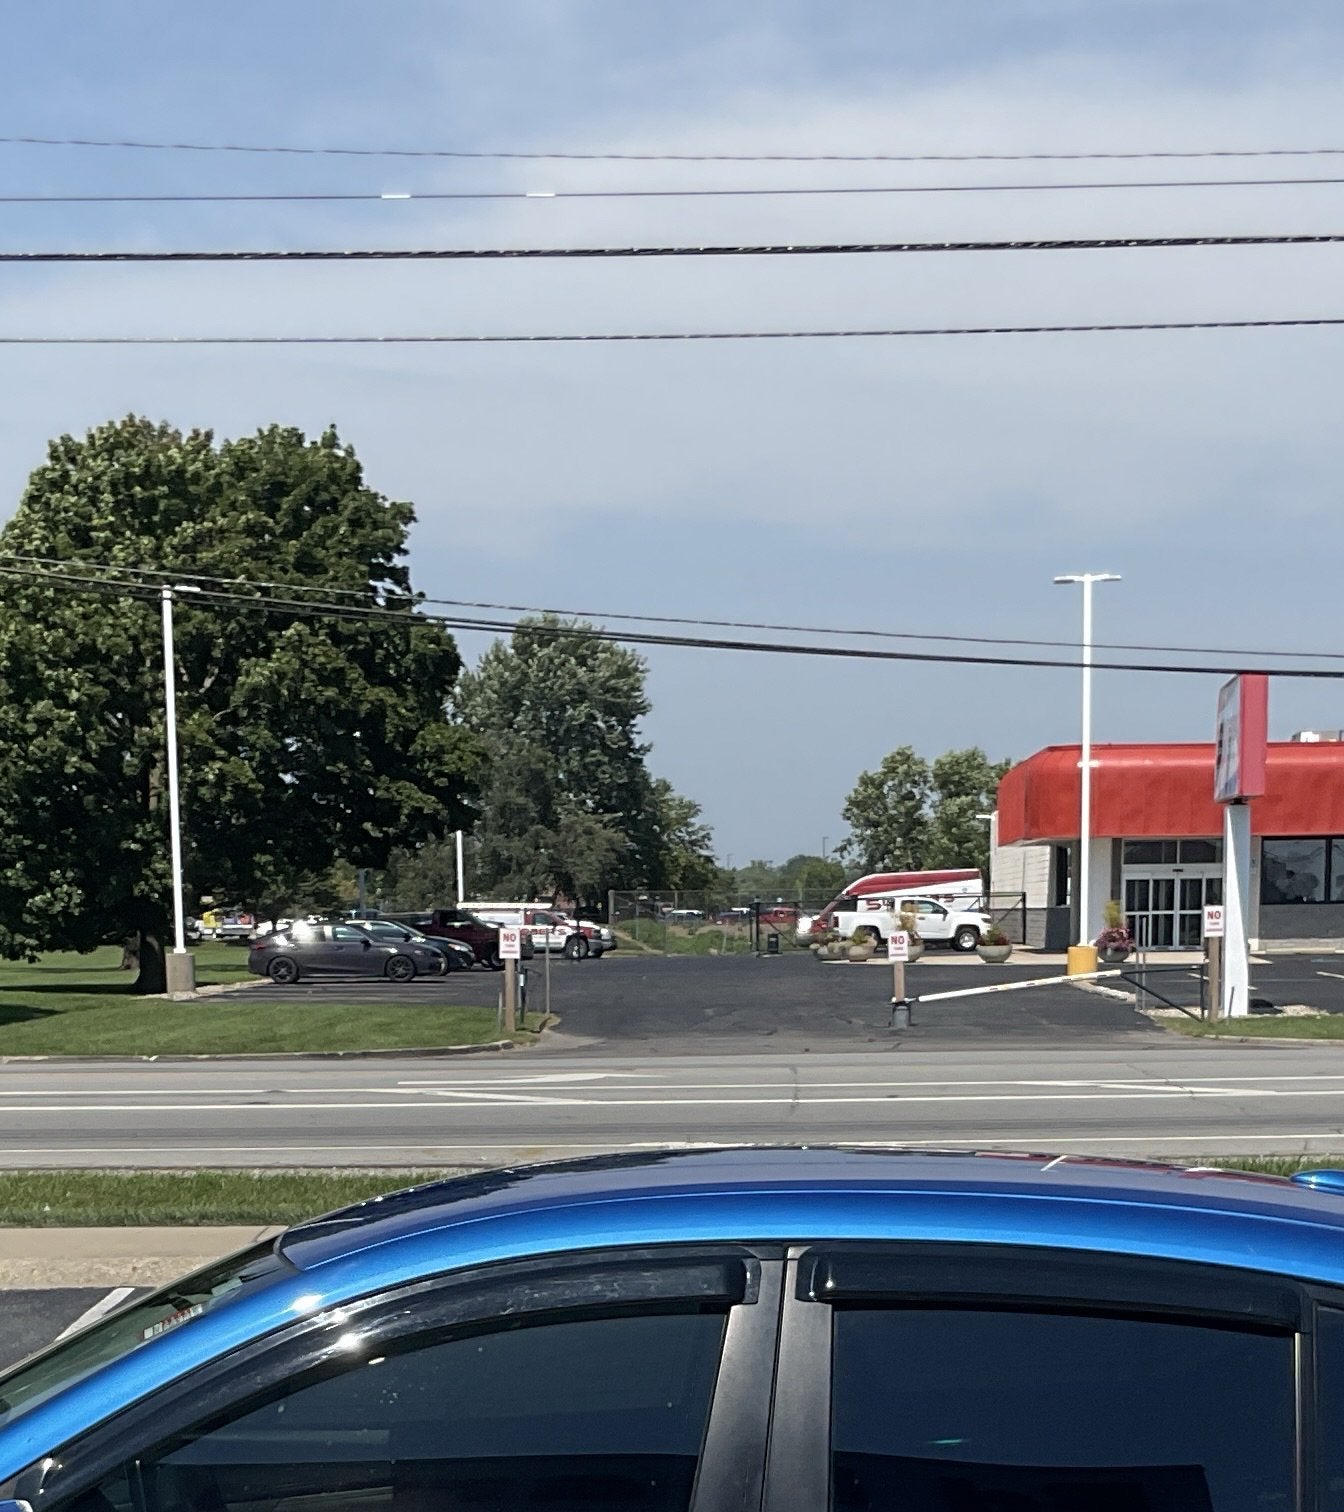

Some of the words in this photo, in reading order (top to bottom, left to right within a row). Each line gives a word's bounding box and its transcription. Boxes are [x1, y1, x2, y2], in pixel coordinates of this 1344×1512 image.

[1207, 911, 1222, 919] NO
[503, 933, 516, 942] NO
[891, 936, 905, 944] NO
